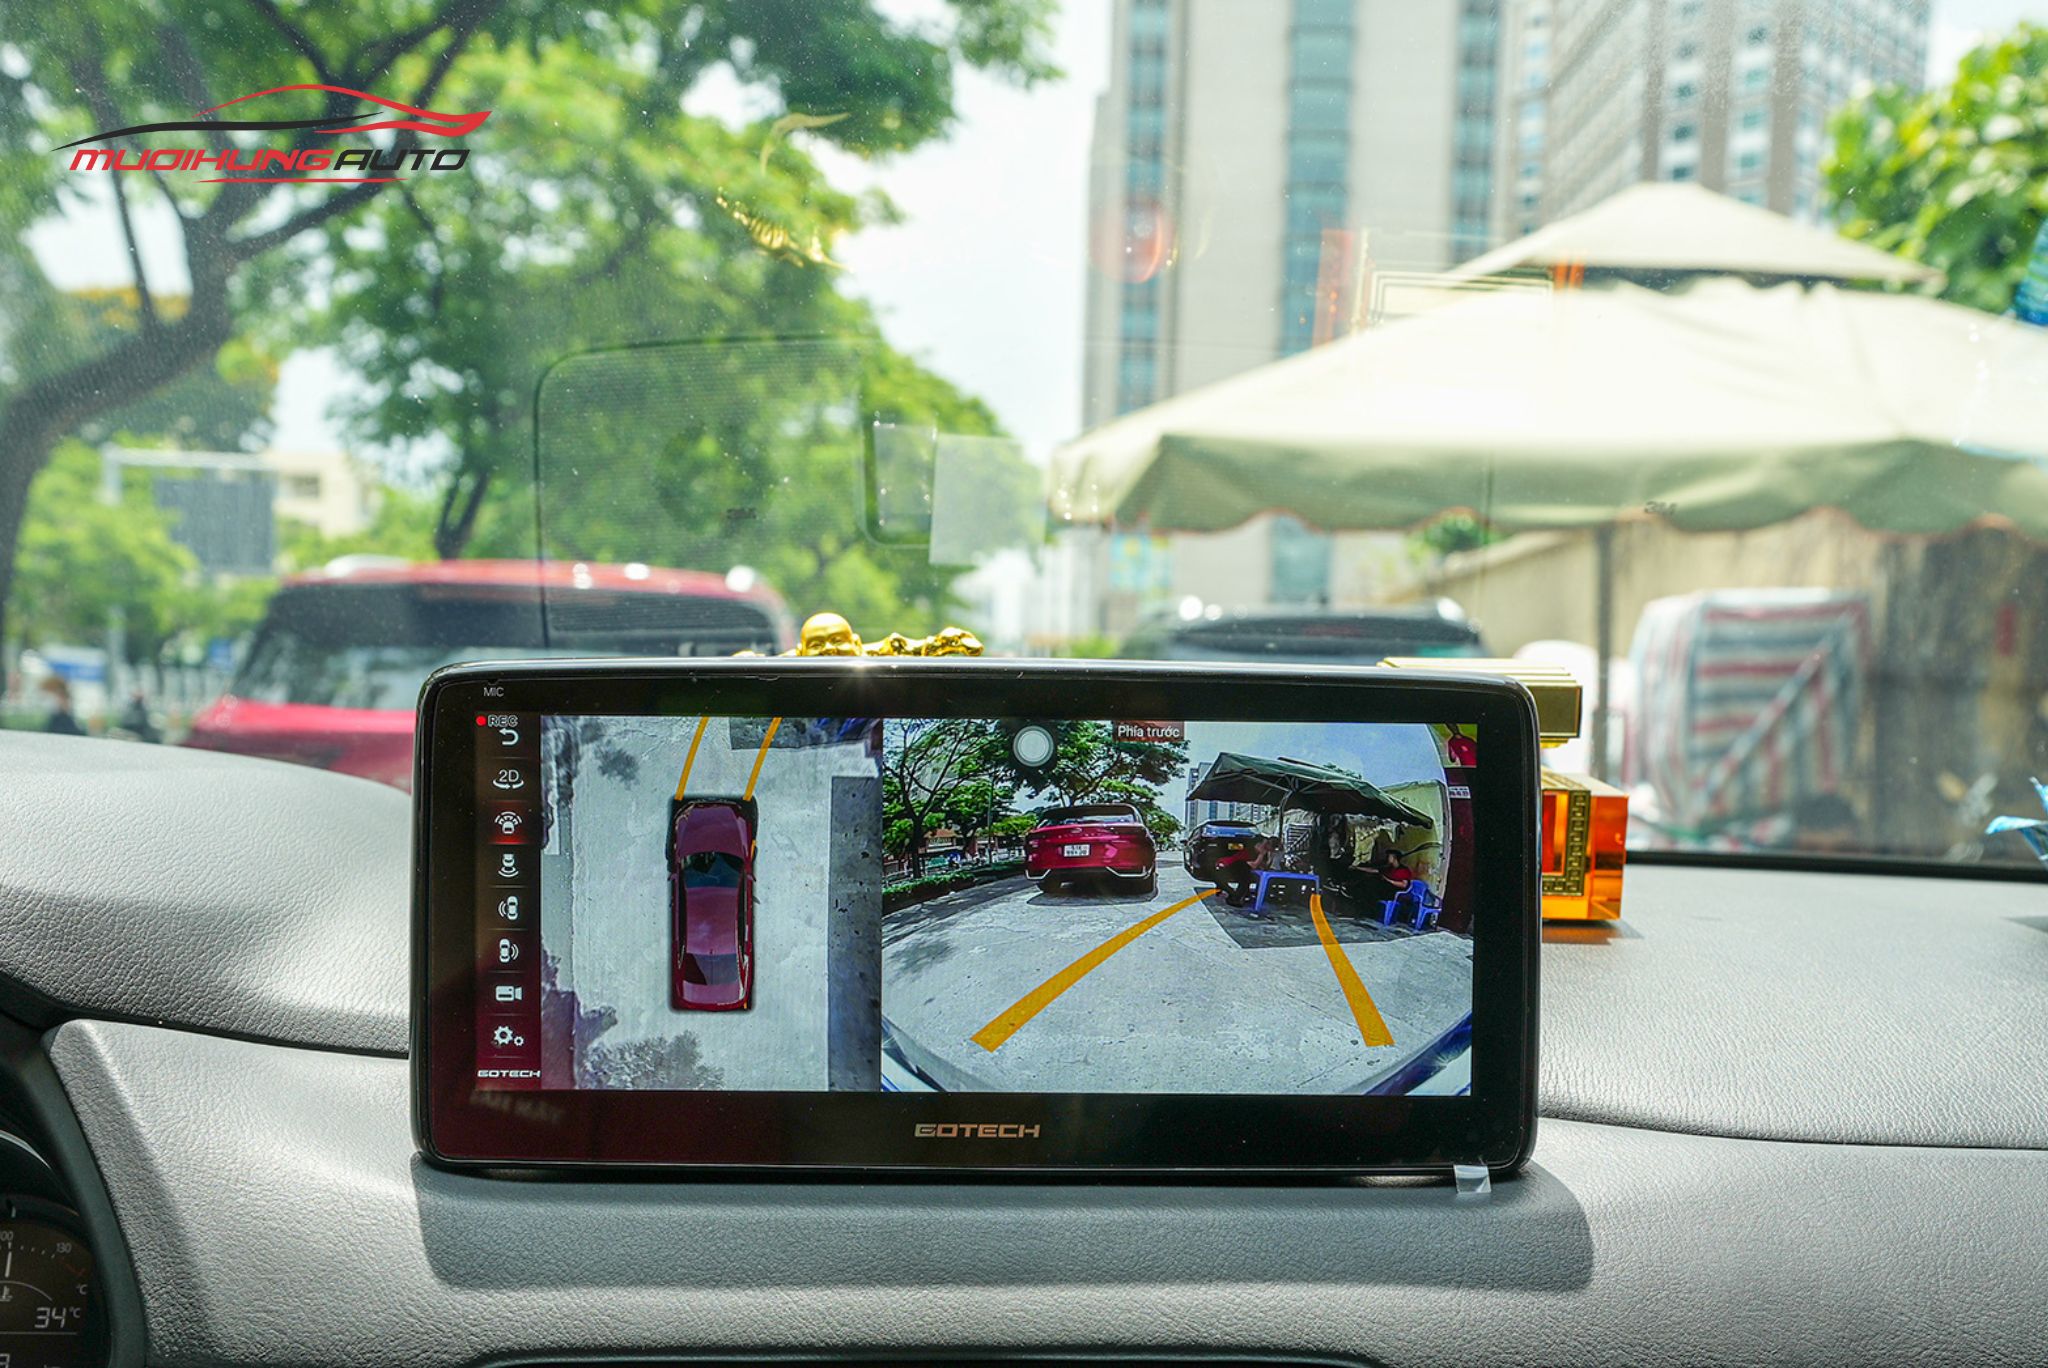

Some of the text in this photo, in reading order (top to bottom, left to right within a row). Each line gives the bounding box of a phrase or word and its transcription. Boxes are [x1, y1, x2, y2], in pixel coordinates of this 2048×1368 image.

[483, 687, 505, 697] MIC
[487, 714, 519, 728] REC
[1117, 724, 1181, 738] Phía trước
[498, 769, 520, 783] 2D
[477, 1069, 542, 1078] GOTECH
[914, 1123, 1041, 1138] GOTECH
[0, 1230, 14, 1241] 00
